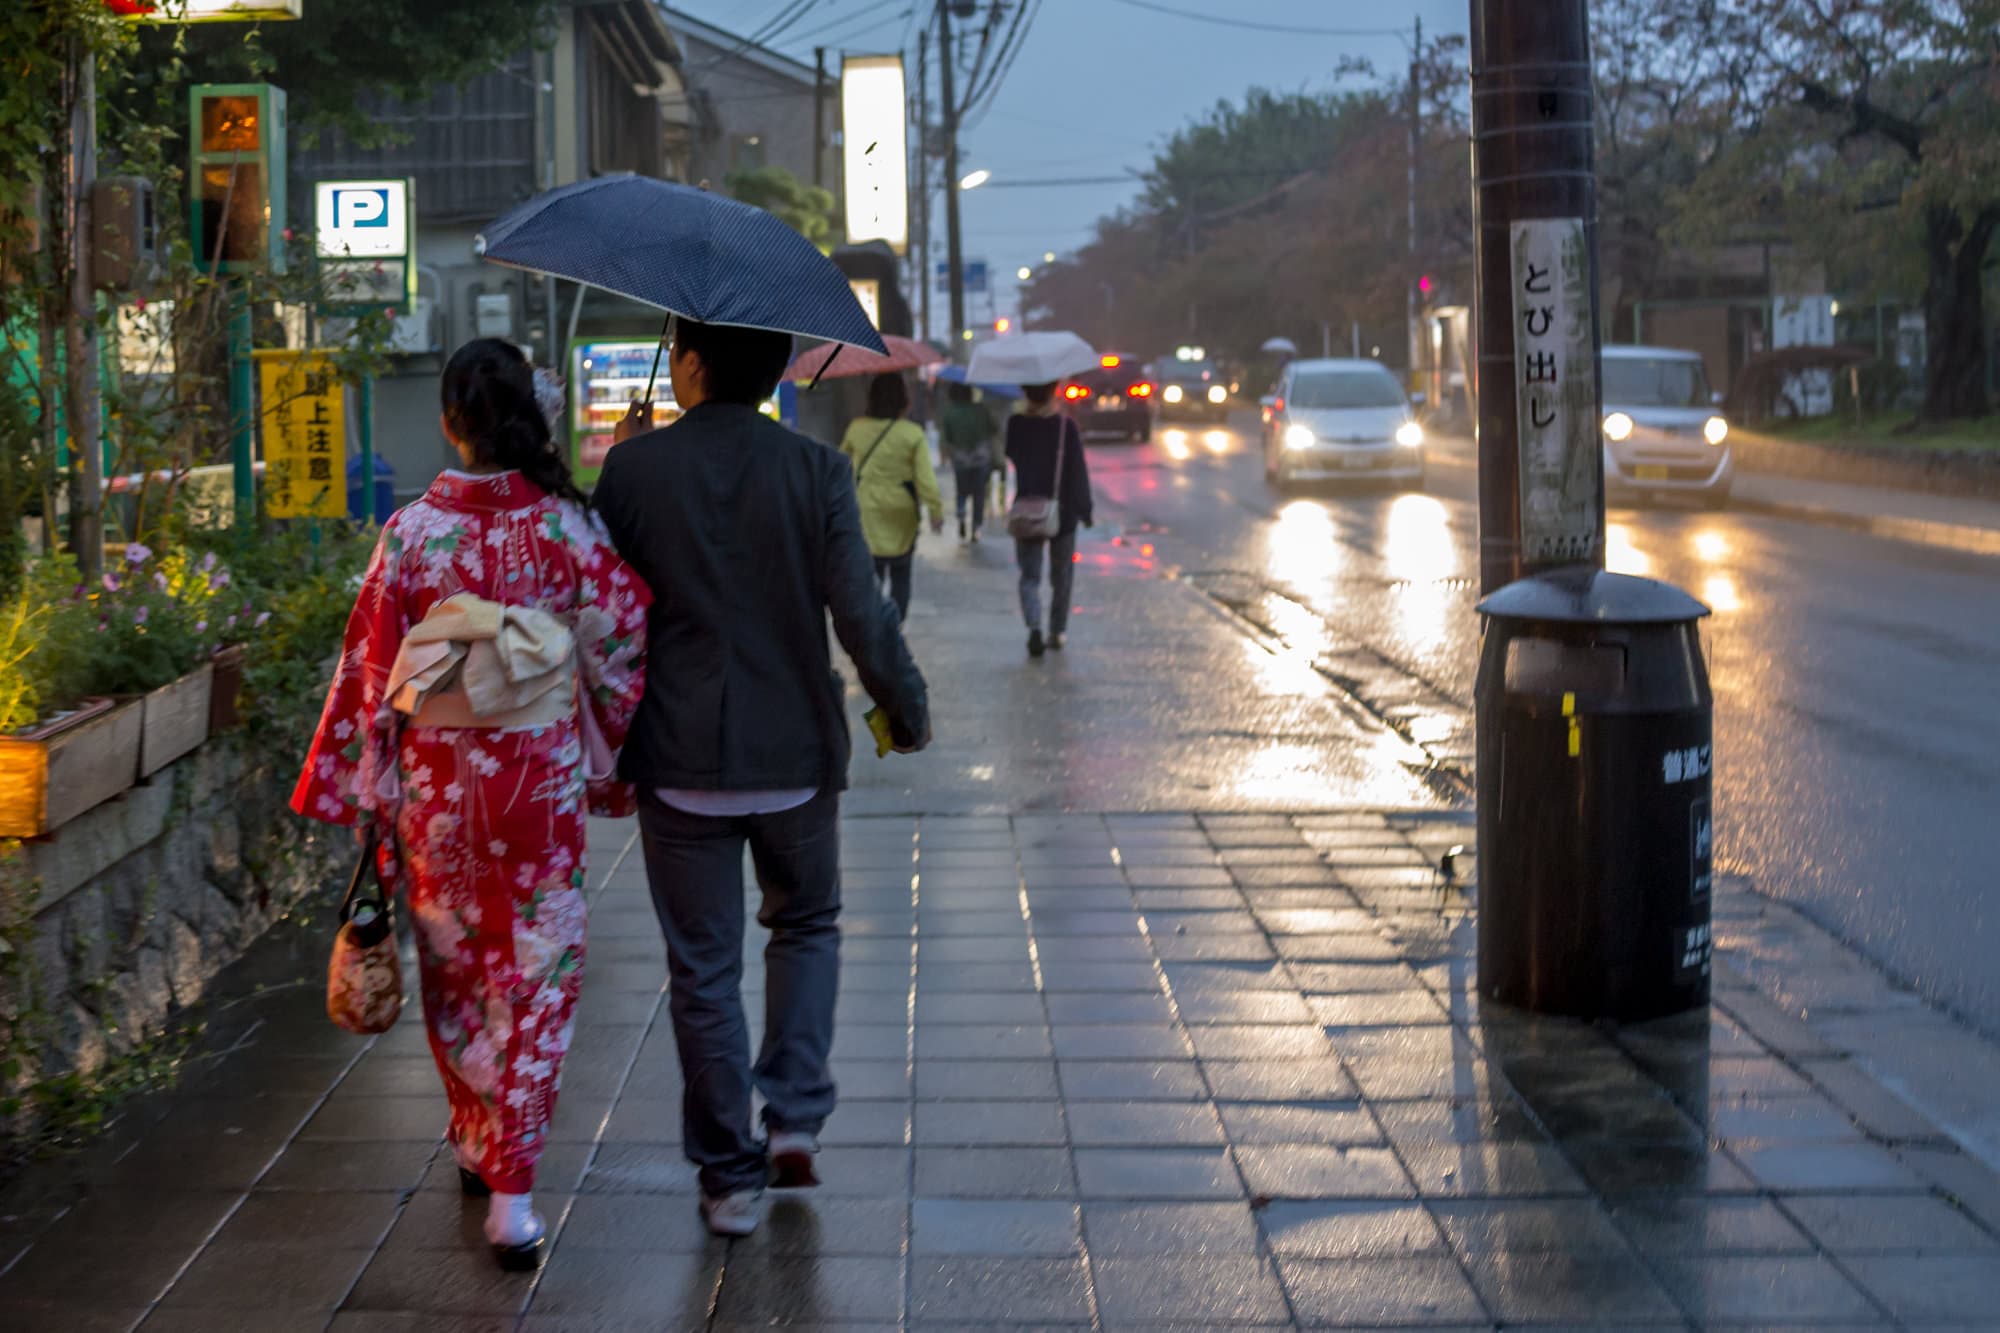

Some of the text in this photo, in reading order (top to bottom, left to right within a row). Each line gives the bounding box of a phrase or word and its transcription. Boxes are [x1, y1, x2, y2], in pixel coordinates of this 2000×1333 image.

[335, 189, 386, 228] P
[1524, 263, 1557, 429] とび出し
